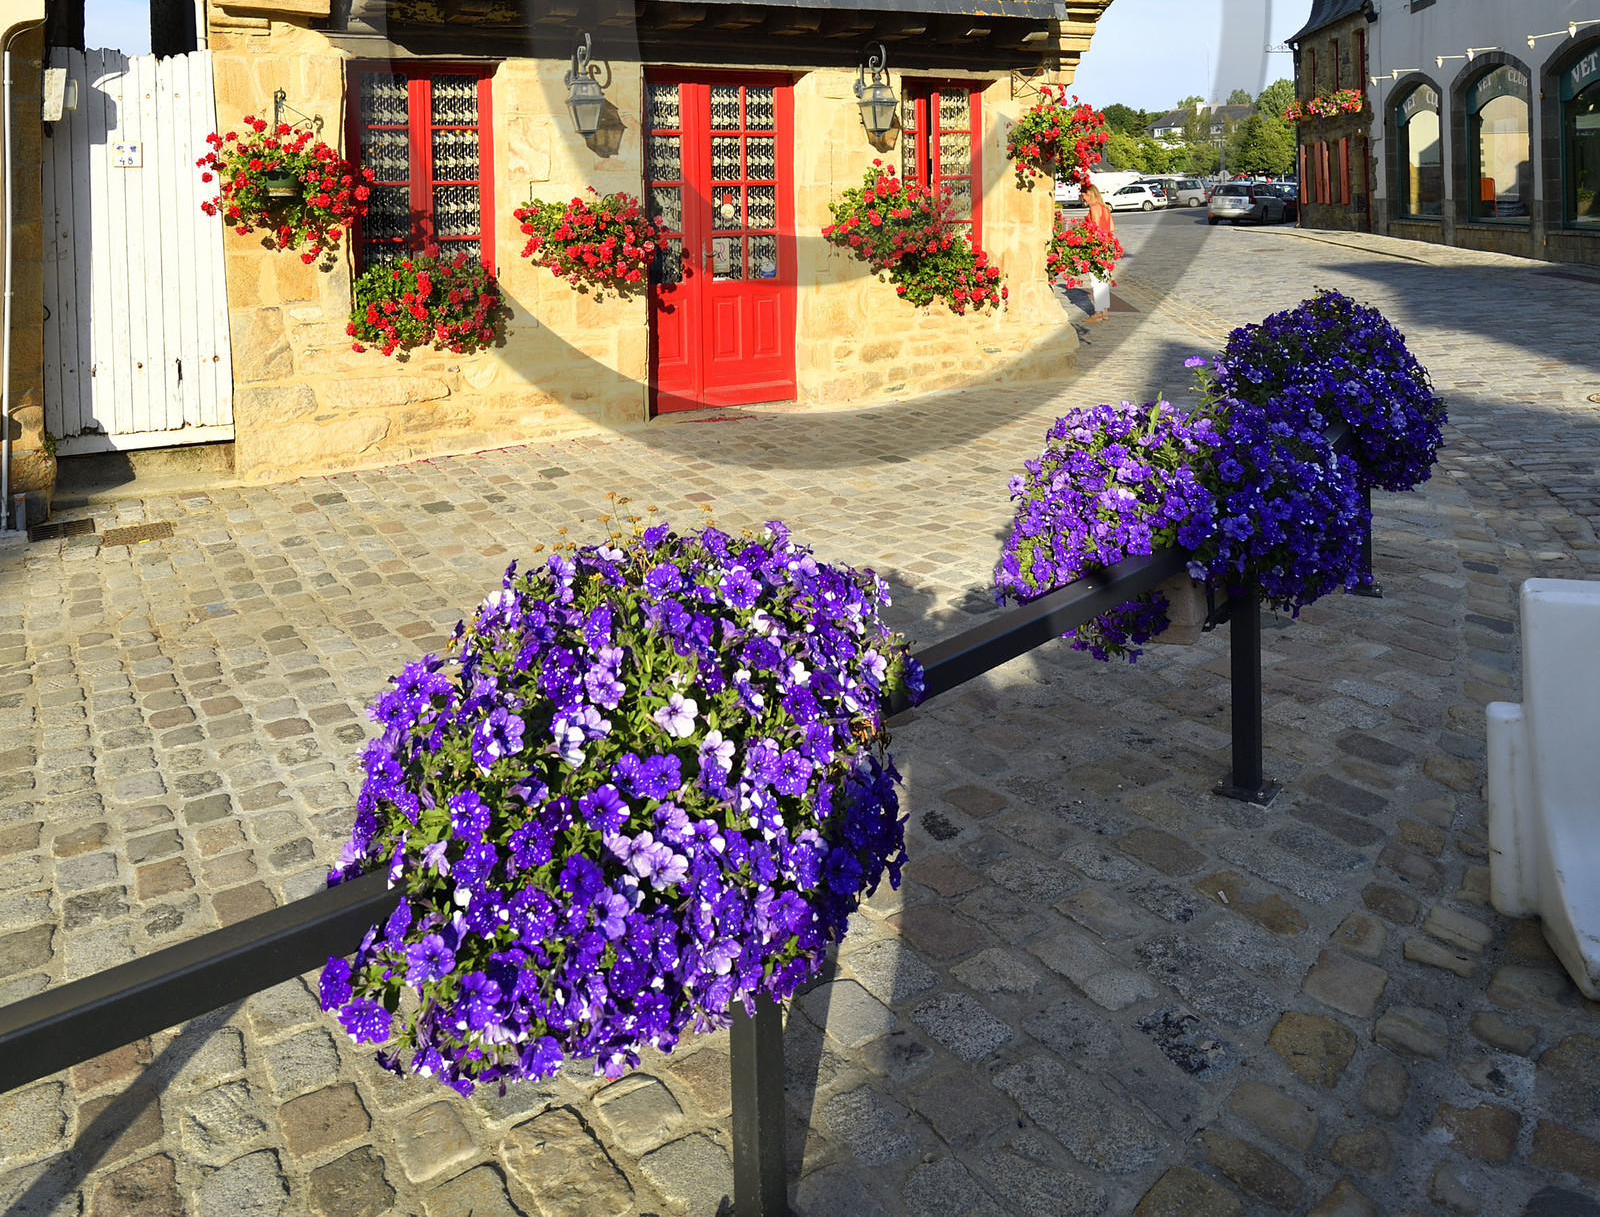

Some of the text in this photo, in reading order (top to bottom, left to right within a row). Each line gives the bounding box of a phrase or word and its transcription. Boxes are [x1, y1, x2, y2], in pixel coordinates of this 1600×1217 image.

[1571, 52, 1598, 83] VET
[1477, 70, 1528, 92] VET CLUB
[1402, 93, 1416, 114] VET
